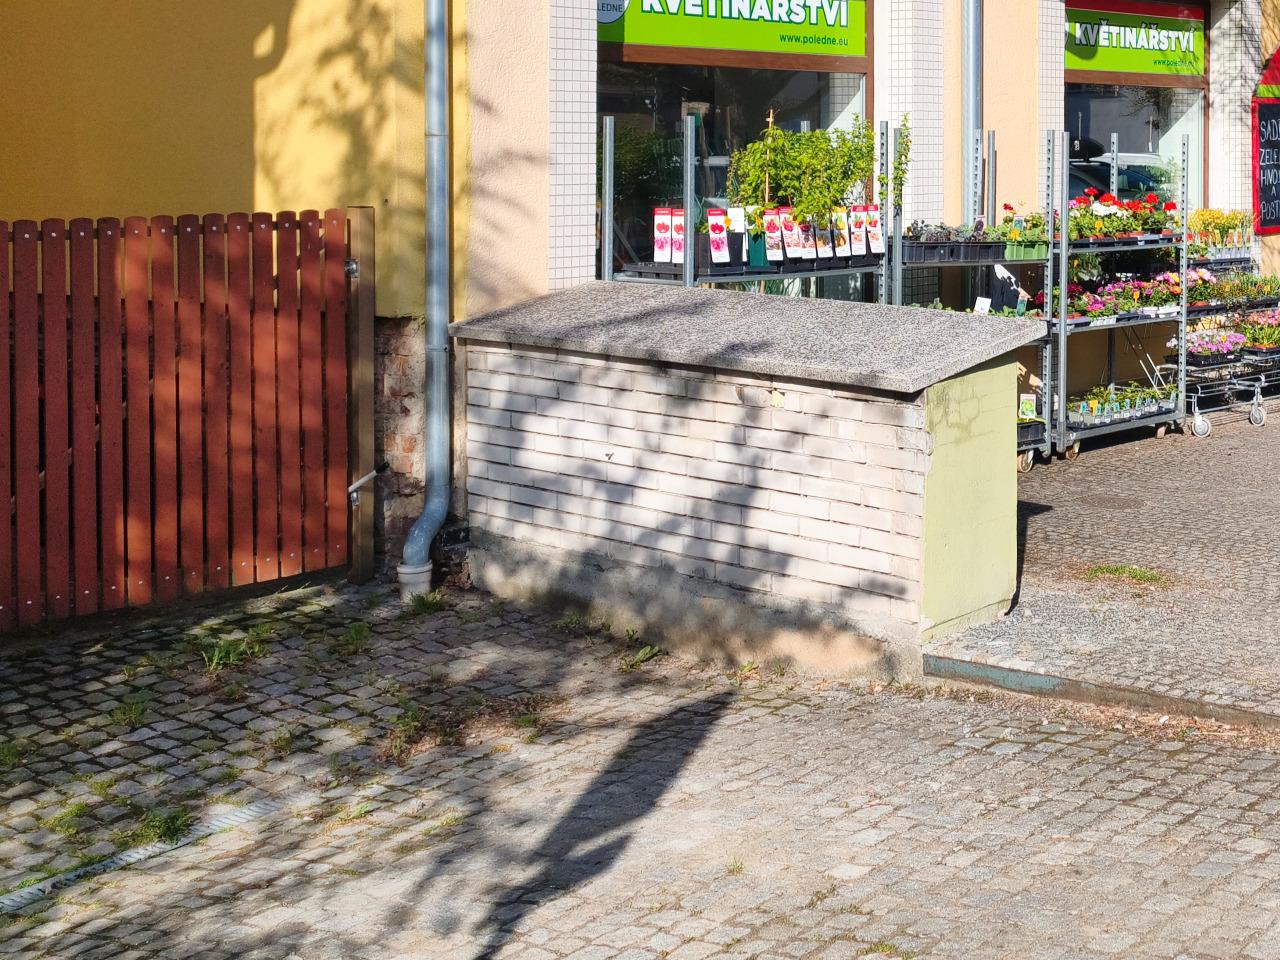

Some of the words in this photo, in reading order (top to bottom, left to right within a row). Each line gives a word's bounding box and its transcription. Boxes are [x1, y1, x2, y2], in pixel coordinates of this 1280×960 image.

[597, 2, 624, 13] LEDNE
[779, 34, 849, 46] www.poledne.eu
[1074, 17, 1194, 53] KVĚTINÁŘSTVÍ
[1271, 185, 1277, 197] A
